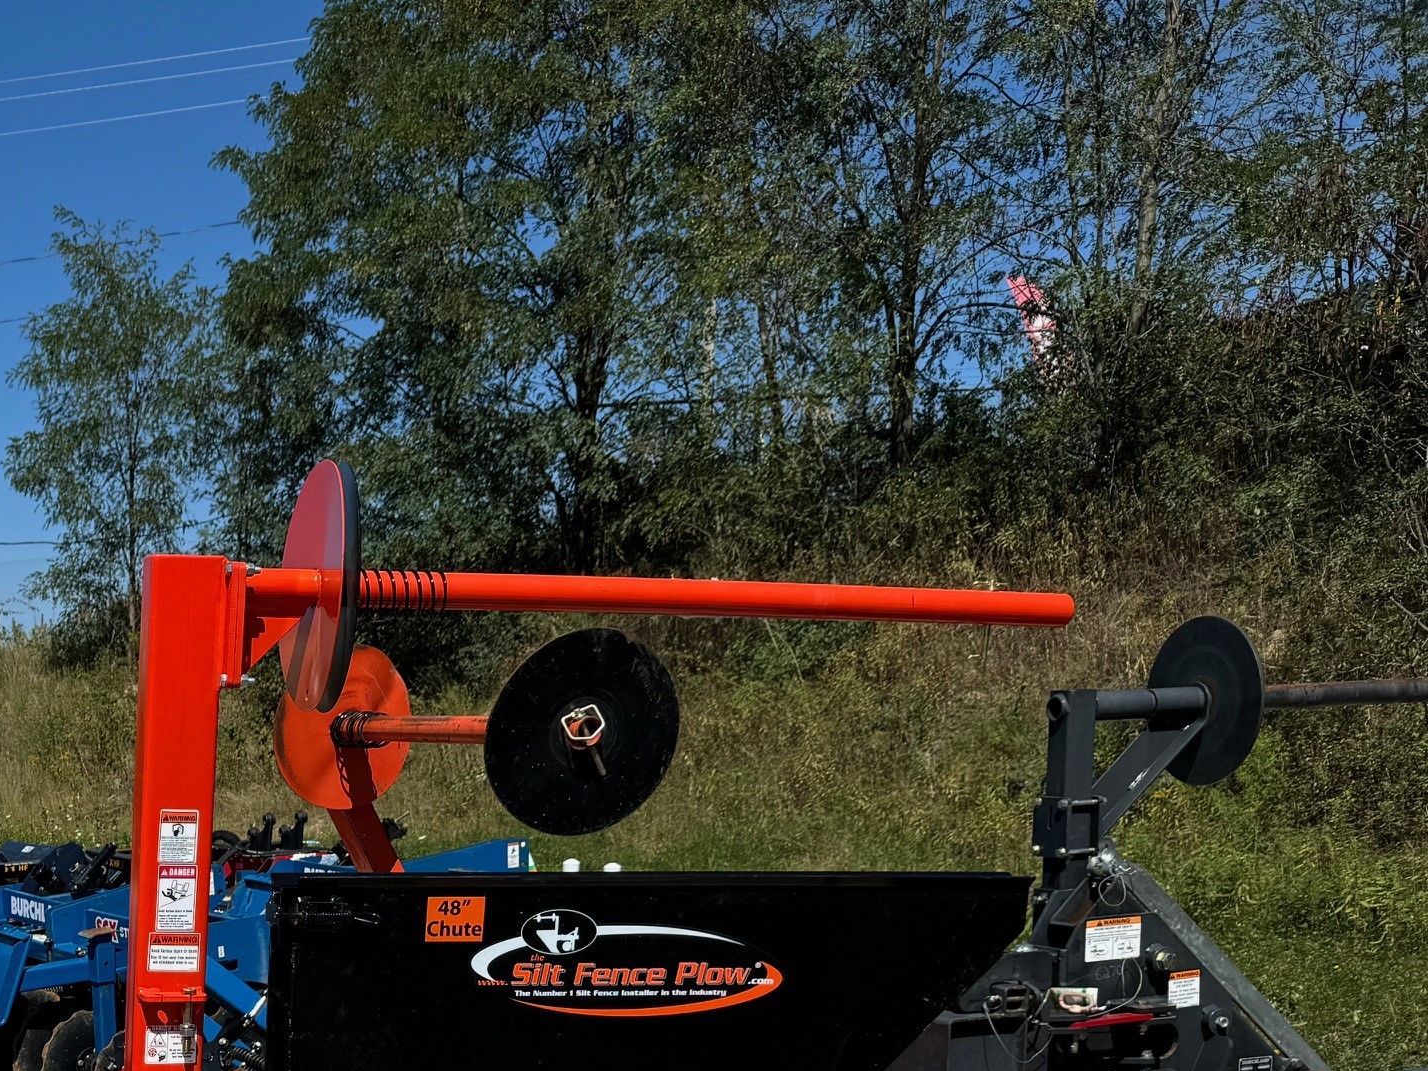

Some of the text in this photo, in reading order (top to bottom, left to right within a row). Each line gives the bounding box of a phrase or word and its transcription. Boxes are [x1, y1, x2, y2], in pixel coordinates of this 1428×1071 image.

[169, 868, 195, 876] DANGER
[427, 921, 482, 937] Chute
[161, 935, 198, 943] WARNING
[530, 954, 545, 962] the
[511, 963, 566, 986] Silt
[574, 963, 667, 987] Fence
[674, 962, 751, 986] Plow
[672, 988, 687, 996] the
[689, 988, 727, 997] Industry
